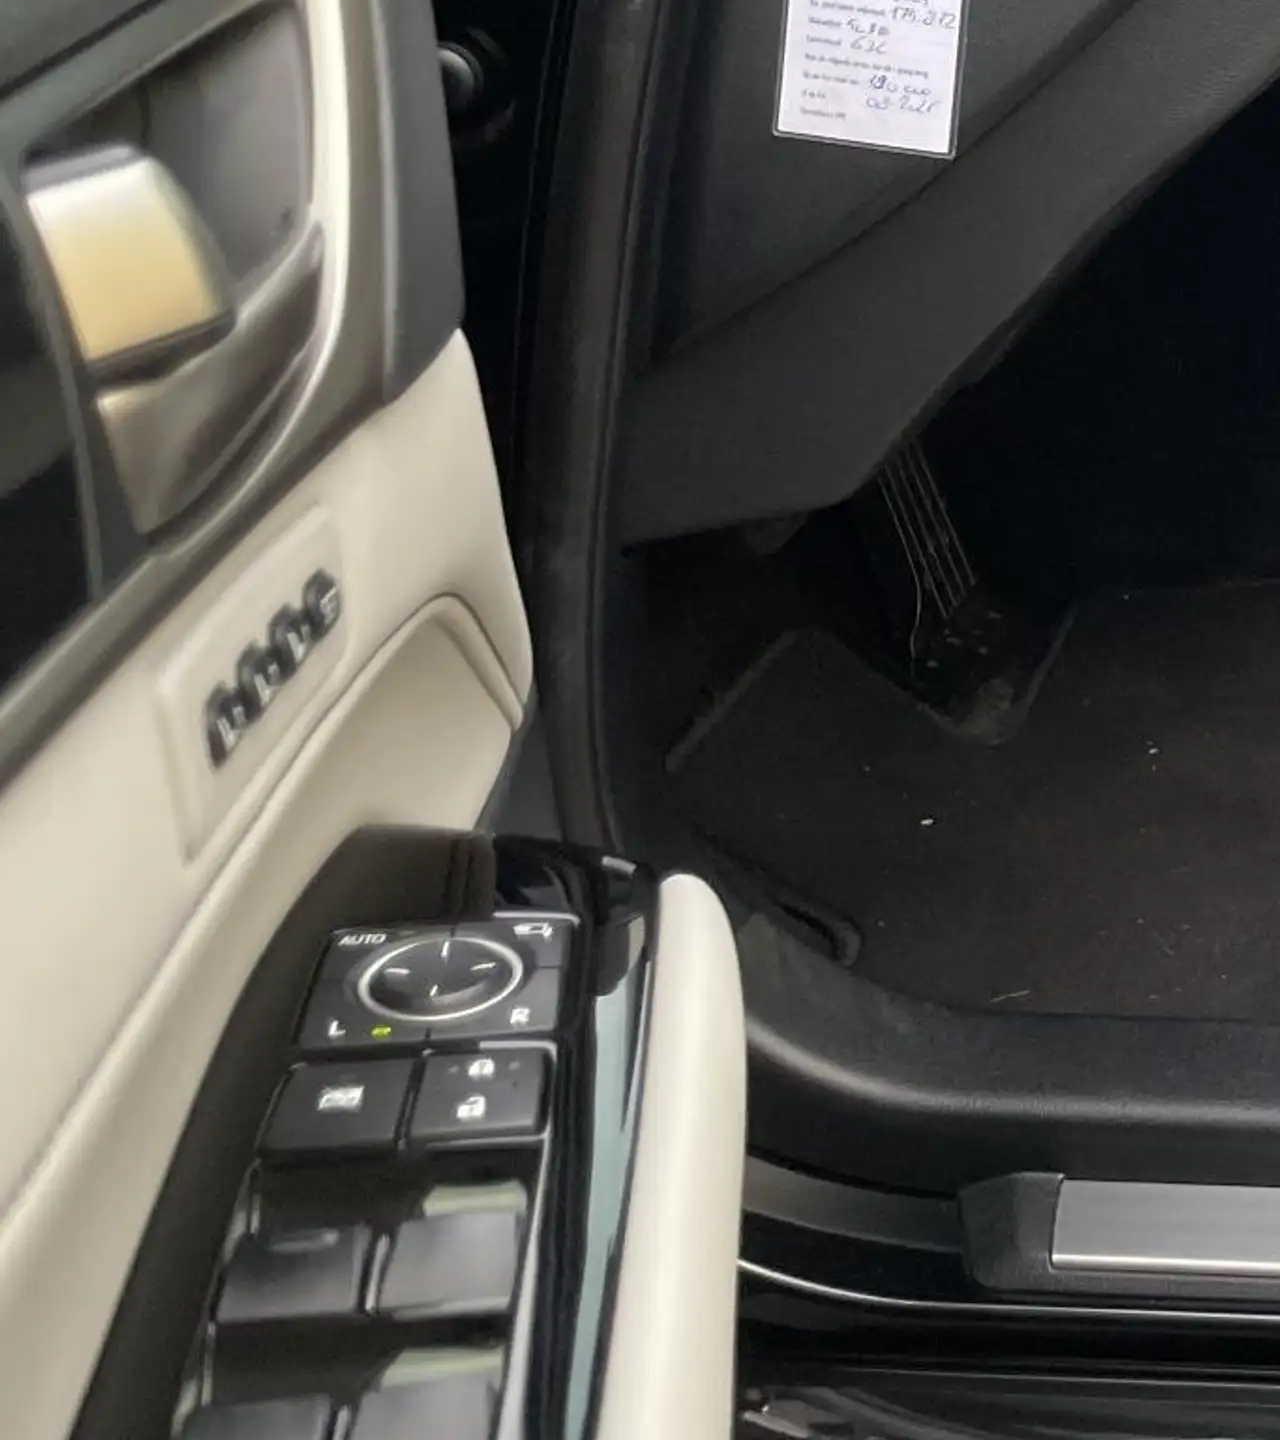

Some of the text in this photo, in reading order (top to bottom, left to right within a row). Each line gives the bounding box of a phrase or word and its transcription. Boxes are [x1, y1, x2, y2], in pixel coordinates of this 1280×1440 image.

[338, 933, 387, 946] AUTO
[329, 1008, 530, 1037] L R
